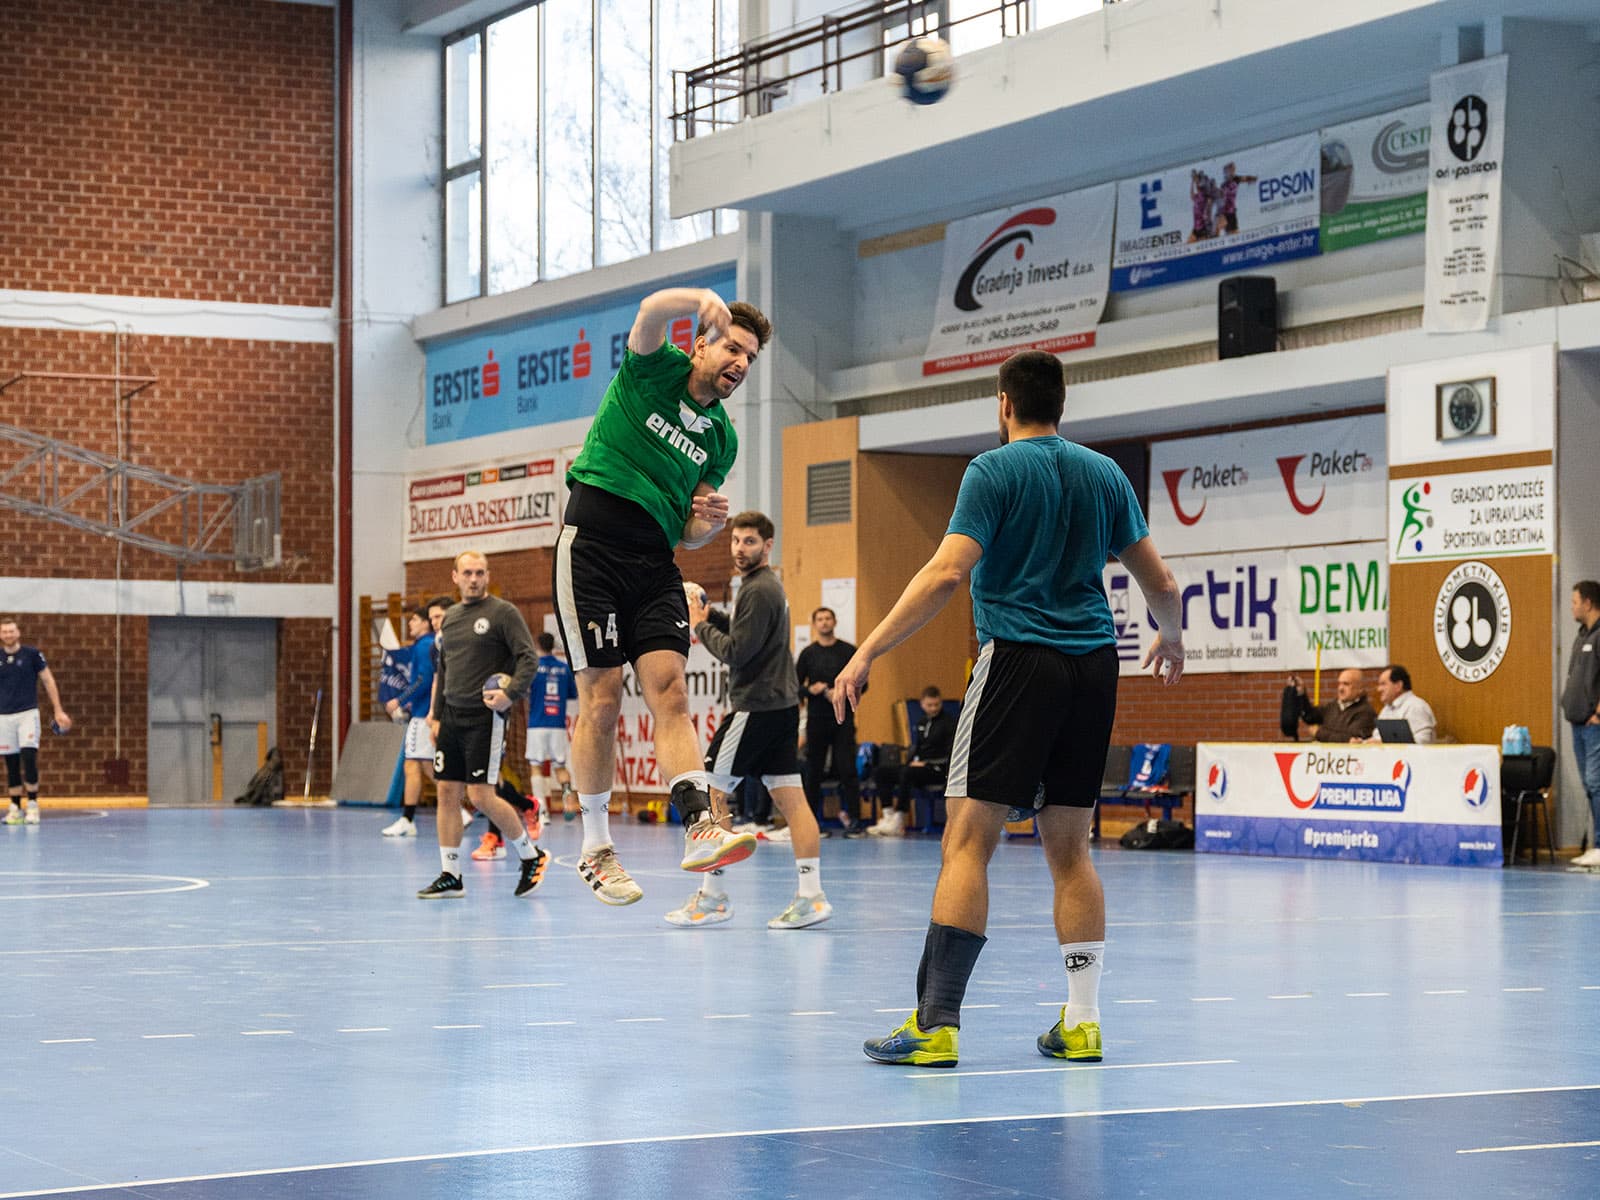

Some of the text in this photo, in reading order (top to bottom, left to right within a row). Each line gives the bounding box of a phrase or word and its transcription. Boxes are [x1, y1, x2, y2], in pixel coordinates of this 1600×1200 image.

[1259, 169, 1315, 203] EPSON
[976, 267, 1023, 295] Gradnja
[1028, 258, 1070, 284] invest
[518, 346, 569, 390] ERSTE
[433, 366, 480, 408] ERSTE
[645, 412, 708, 467] erima
[1451, 485, 1495, 504] GRADSKO
[1471, 503, 1544, 525] ZA UPRAVLJANJE
[1495, 527, 1544, 546] OBJEKTIMA
[1492, 581, 1508, 633] KLUB
[587, 613, 618, 649] 14
[1443, 647, 1503, 680] BJELOVAR
[1319, 788, 1402, 807] PREMIJER LIGA
[1304, 827, 1379, 849] #premijerka
